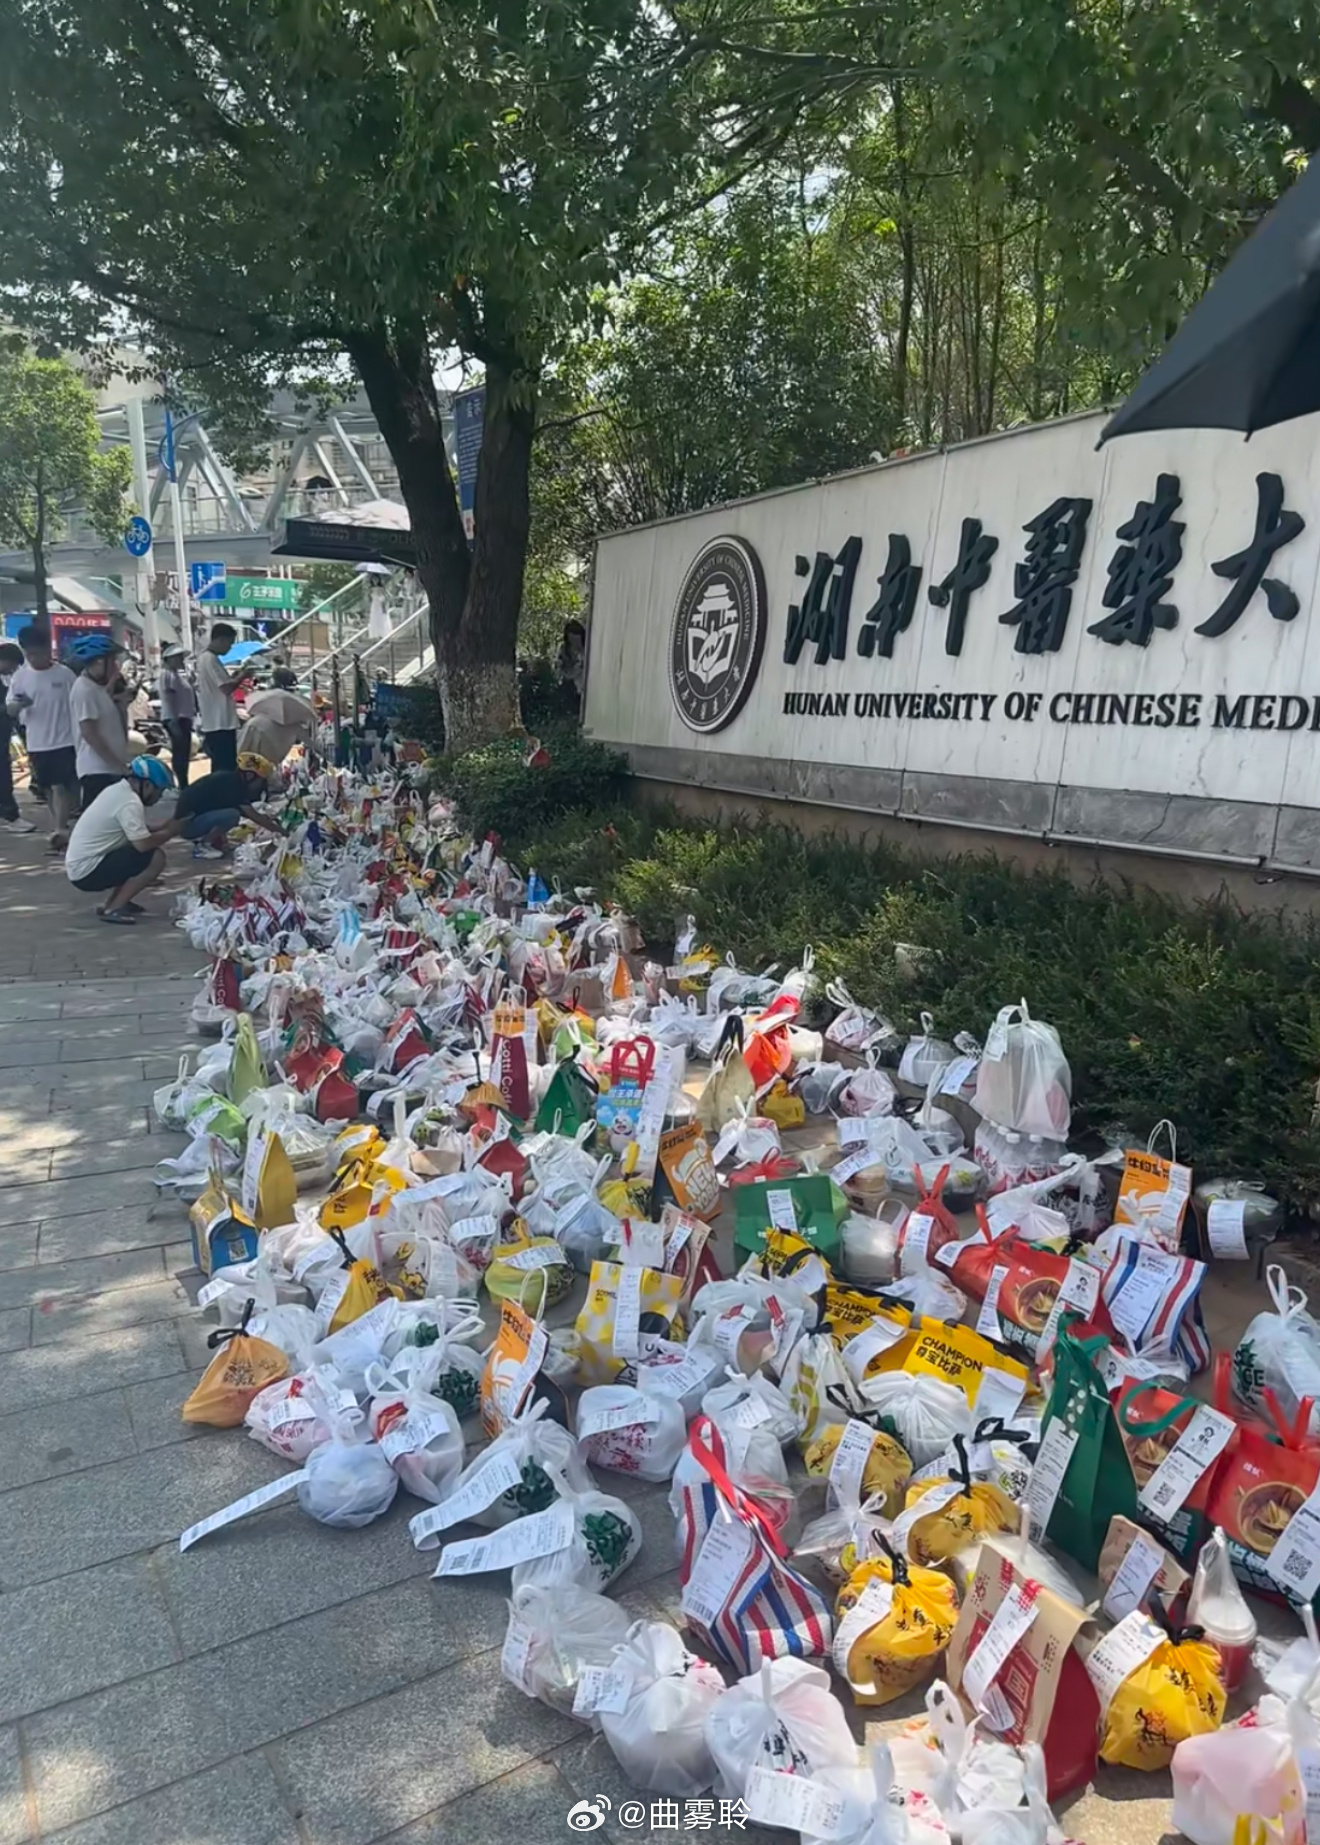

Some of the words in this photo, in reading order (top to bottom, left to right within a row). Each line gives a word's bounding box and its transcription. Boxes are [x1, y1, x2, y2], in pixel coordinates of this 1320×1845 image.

[782, 691, 851, 717] HUNAN
[853, 692, 999, 722] UNIVERSITY
[1003, 691, 1044, 722] OF
[1049, 691, 1203, 728] CHINESE
[915, 1345, 963, 1376] 尊宝比萨
[922, 1336, 983, 1372] CHAMPION
